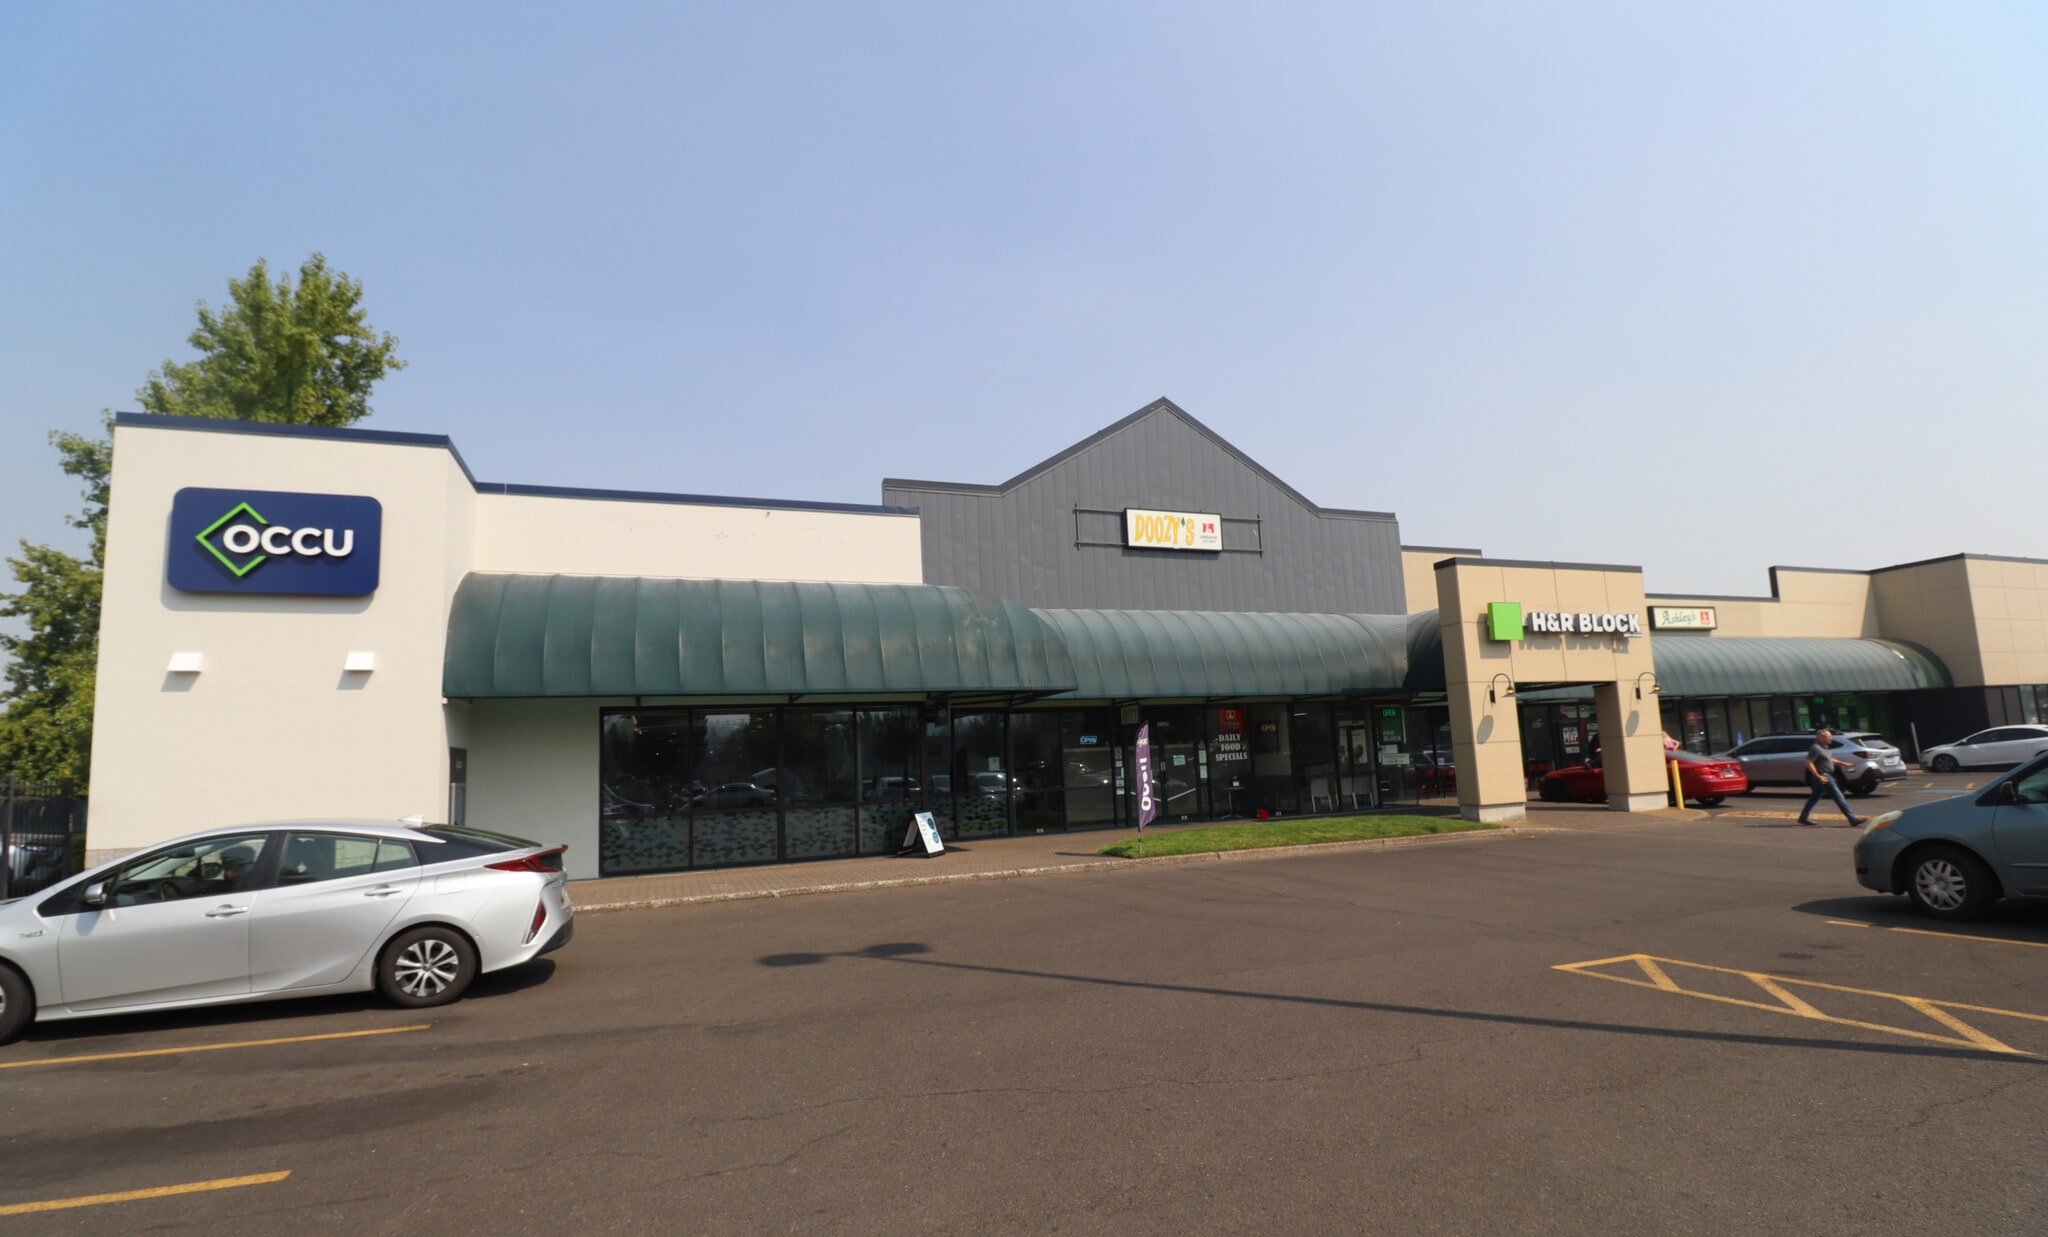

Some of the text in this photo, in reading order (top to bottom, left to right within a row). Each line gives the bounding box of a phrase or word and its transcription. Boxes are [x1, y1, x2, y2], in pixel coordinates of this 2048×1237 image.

[1134, 514, 1195, 545] DOOZY'S
[223, 524, 354, 556] OCCU
[1532, 612, 1641, 633] H&R BLOCK
[1081, 736, 1097, 744] OPEN
[1218, 733, 1241, 742] DAILY
[1220, 743, 1241, 751] FOOD
[1215, 752, 1248, 761] SPECIALS
